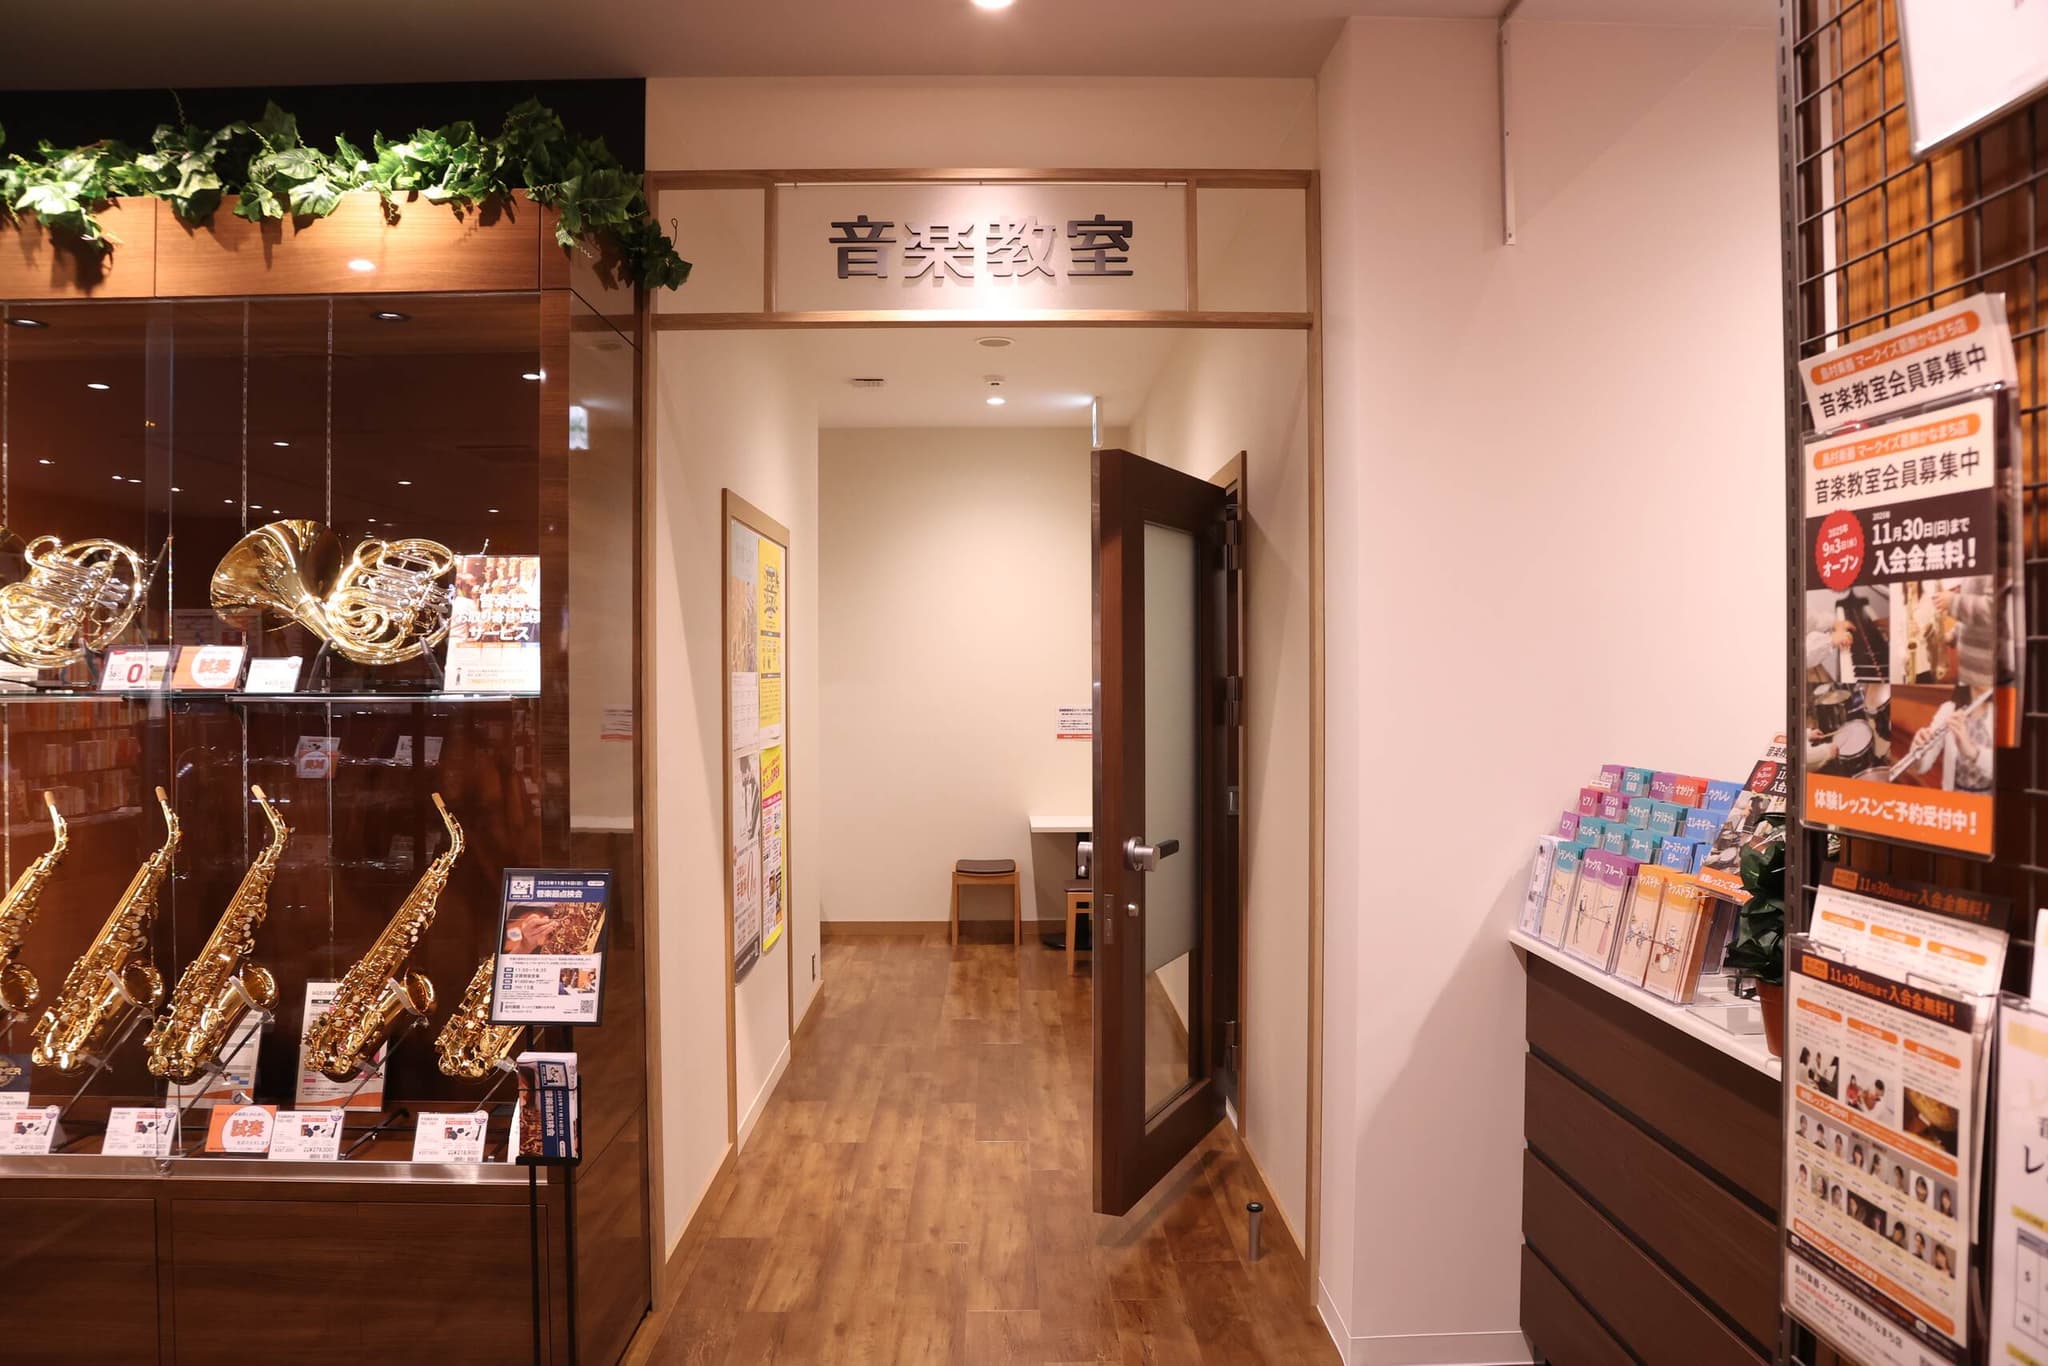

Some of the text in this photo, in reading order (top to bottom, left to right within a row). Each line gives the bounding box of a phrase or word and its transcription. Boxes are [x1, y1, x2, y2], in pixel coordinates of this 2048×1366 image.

[828, 214, 1133, 279] 音楽教室
[1819, 342, 1988, 418] 音楽教室会員募集中
[1815, 447, 1981, 504] 音楽教室会員募集中
[1872, 516, 1970, 546] 11月30日(日)まで
[1823, 554, 1859, 578] オープン
[468, 627, 530, 641] サービス
[1708, 789, 1730, 801] ウクレレ
[1687, 817, 1717, 831] エレキギター
[1631, 838, 1649, 851] フルート
[1605, 863, 1624, 878] フルート
[230, 1119, 265, 1138] 試奏
